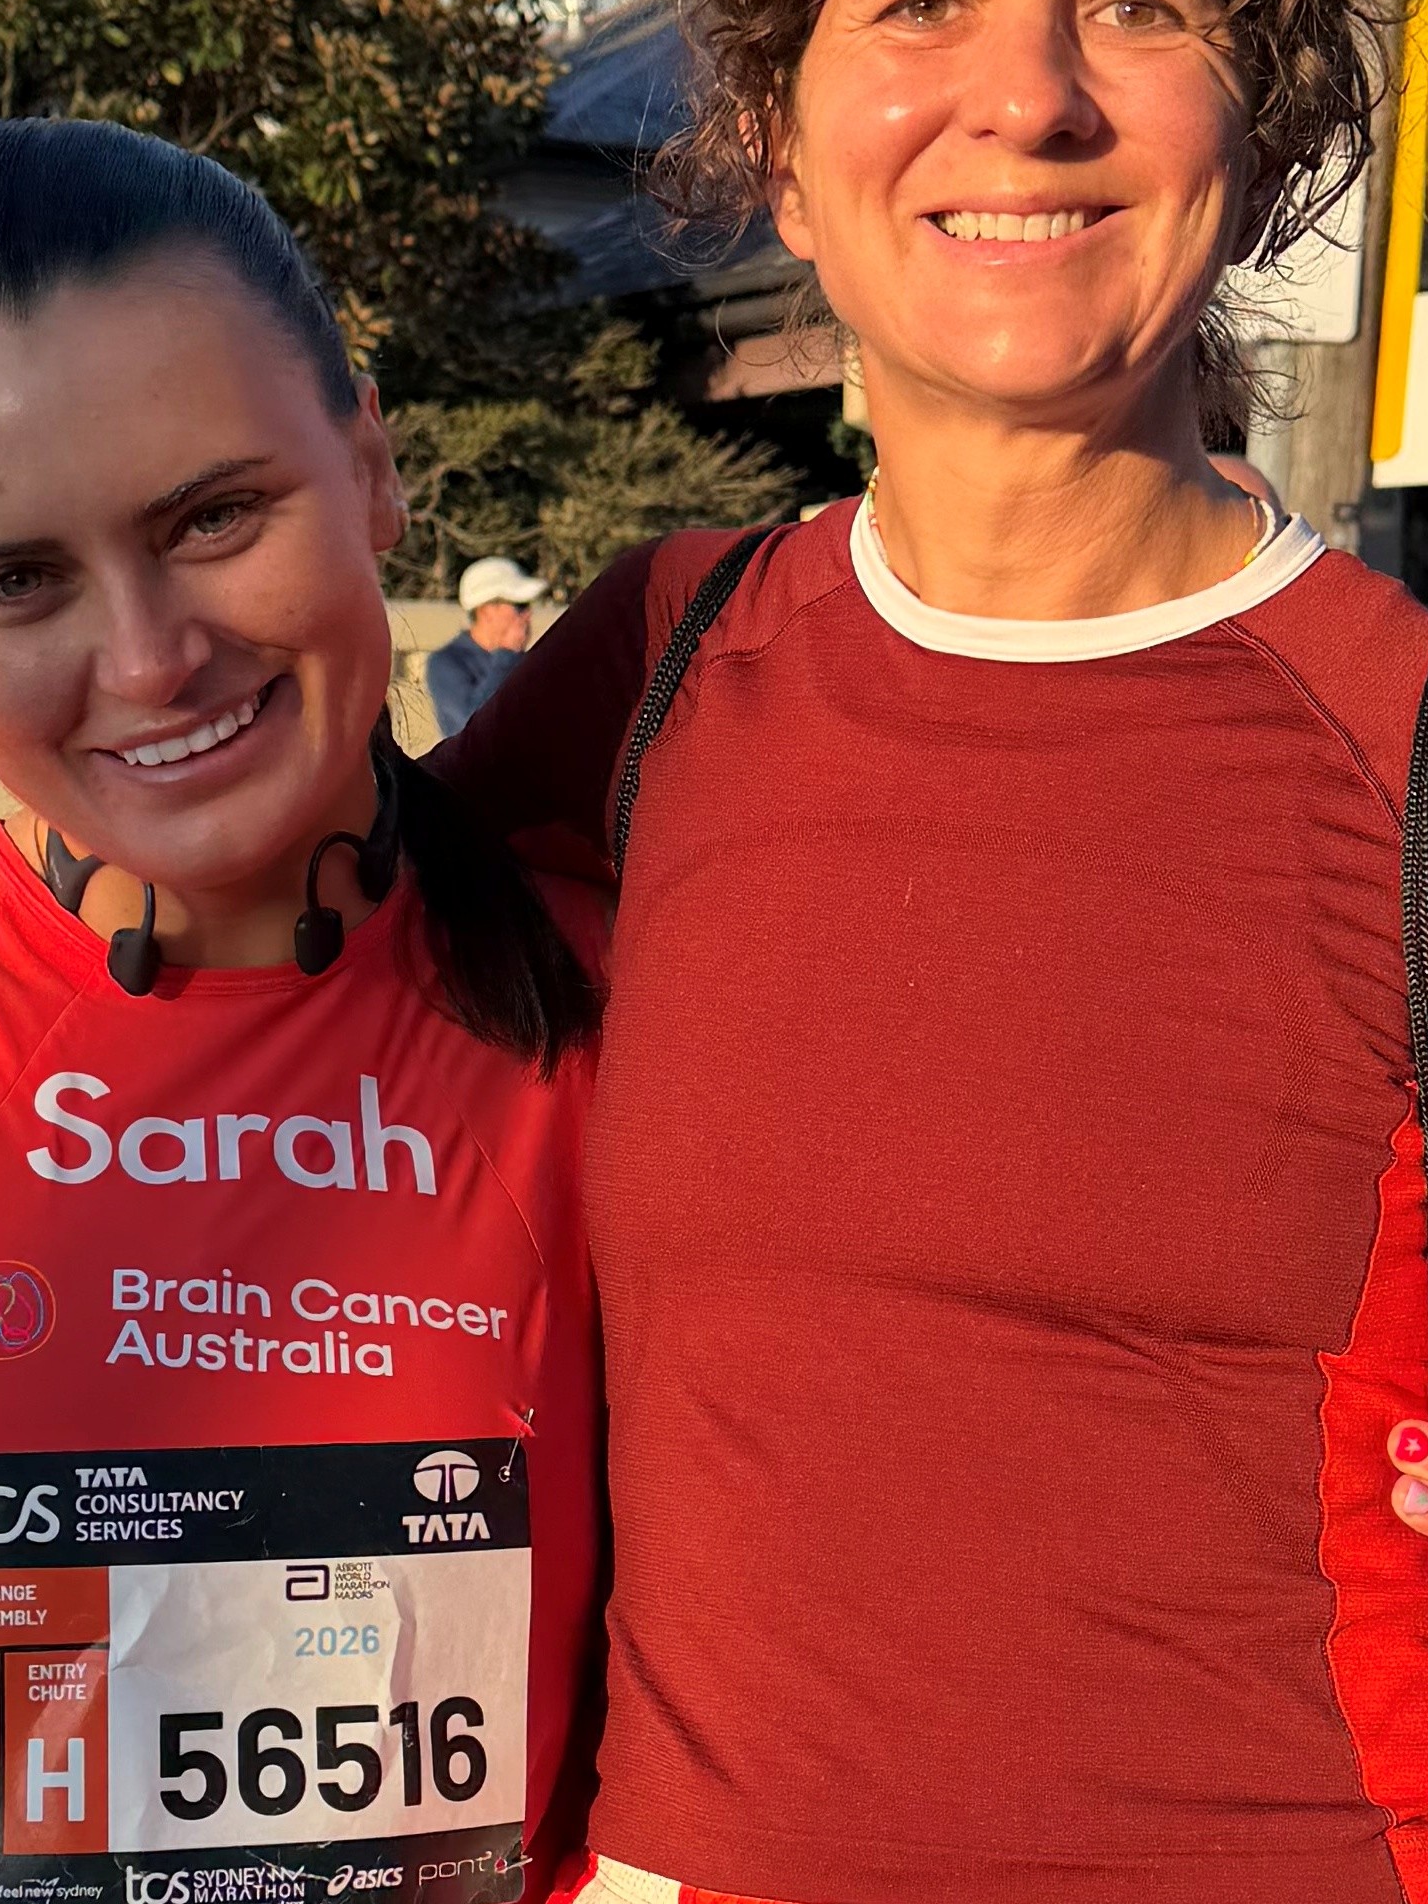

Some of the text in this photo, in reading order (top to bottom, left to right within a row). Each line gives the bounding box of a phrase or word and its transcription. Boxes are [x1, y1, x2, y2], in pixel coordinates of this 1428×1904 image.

[25, 1069, 438, 1196] Sarah
[112, 1269, 508, 1343] Brain Cancer
[104, 1320, 394, 1378] Australia
[75, 1467, 148, 1489] TATA
[75, 1490, 245, 1515] CONSULTANCY
[75, 1519, 183, 1542] SERVICES
[402, 1512, 491, 1544] TATA
[335, 1581, 391, 1591] MARATHON
[335, 1590, 374, 1601] MAJORS
[295, 1624, 381, 1657] 2026
[28, 1662, 87, 1681] ENTRY
[28, 1683, 87, 1702] CHUTE
[159, 1696, 487, 1821] 56516
[27, 1737, 84, 1822] H
[193, 1867, 266, 1889] SYDNEY
[25, 1885, 54, 1898] new
[56, 1885, 103, 1900] sydney
[194, 1883, 305, 1904] MARATHON
